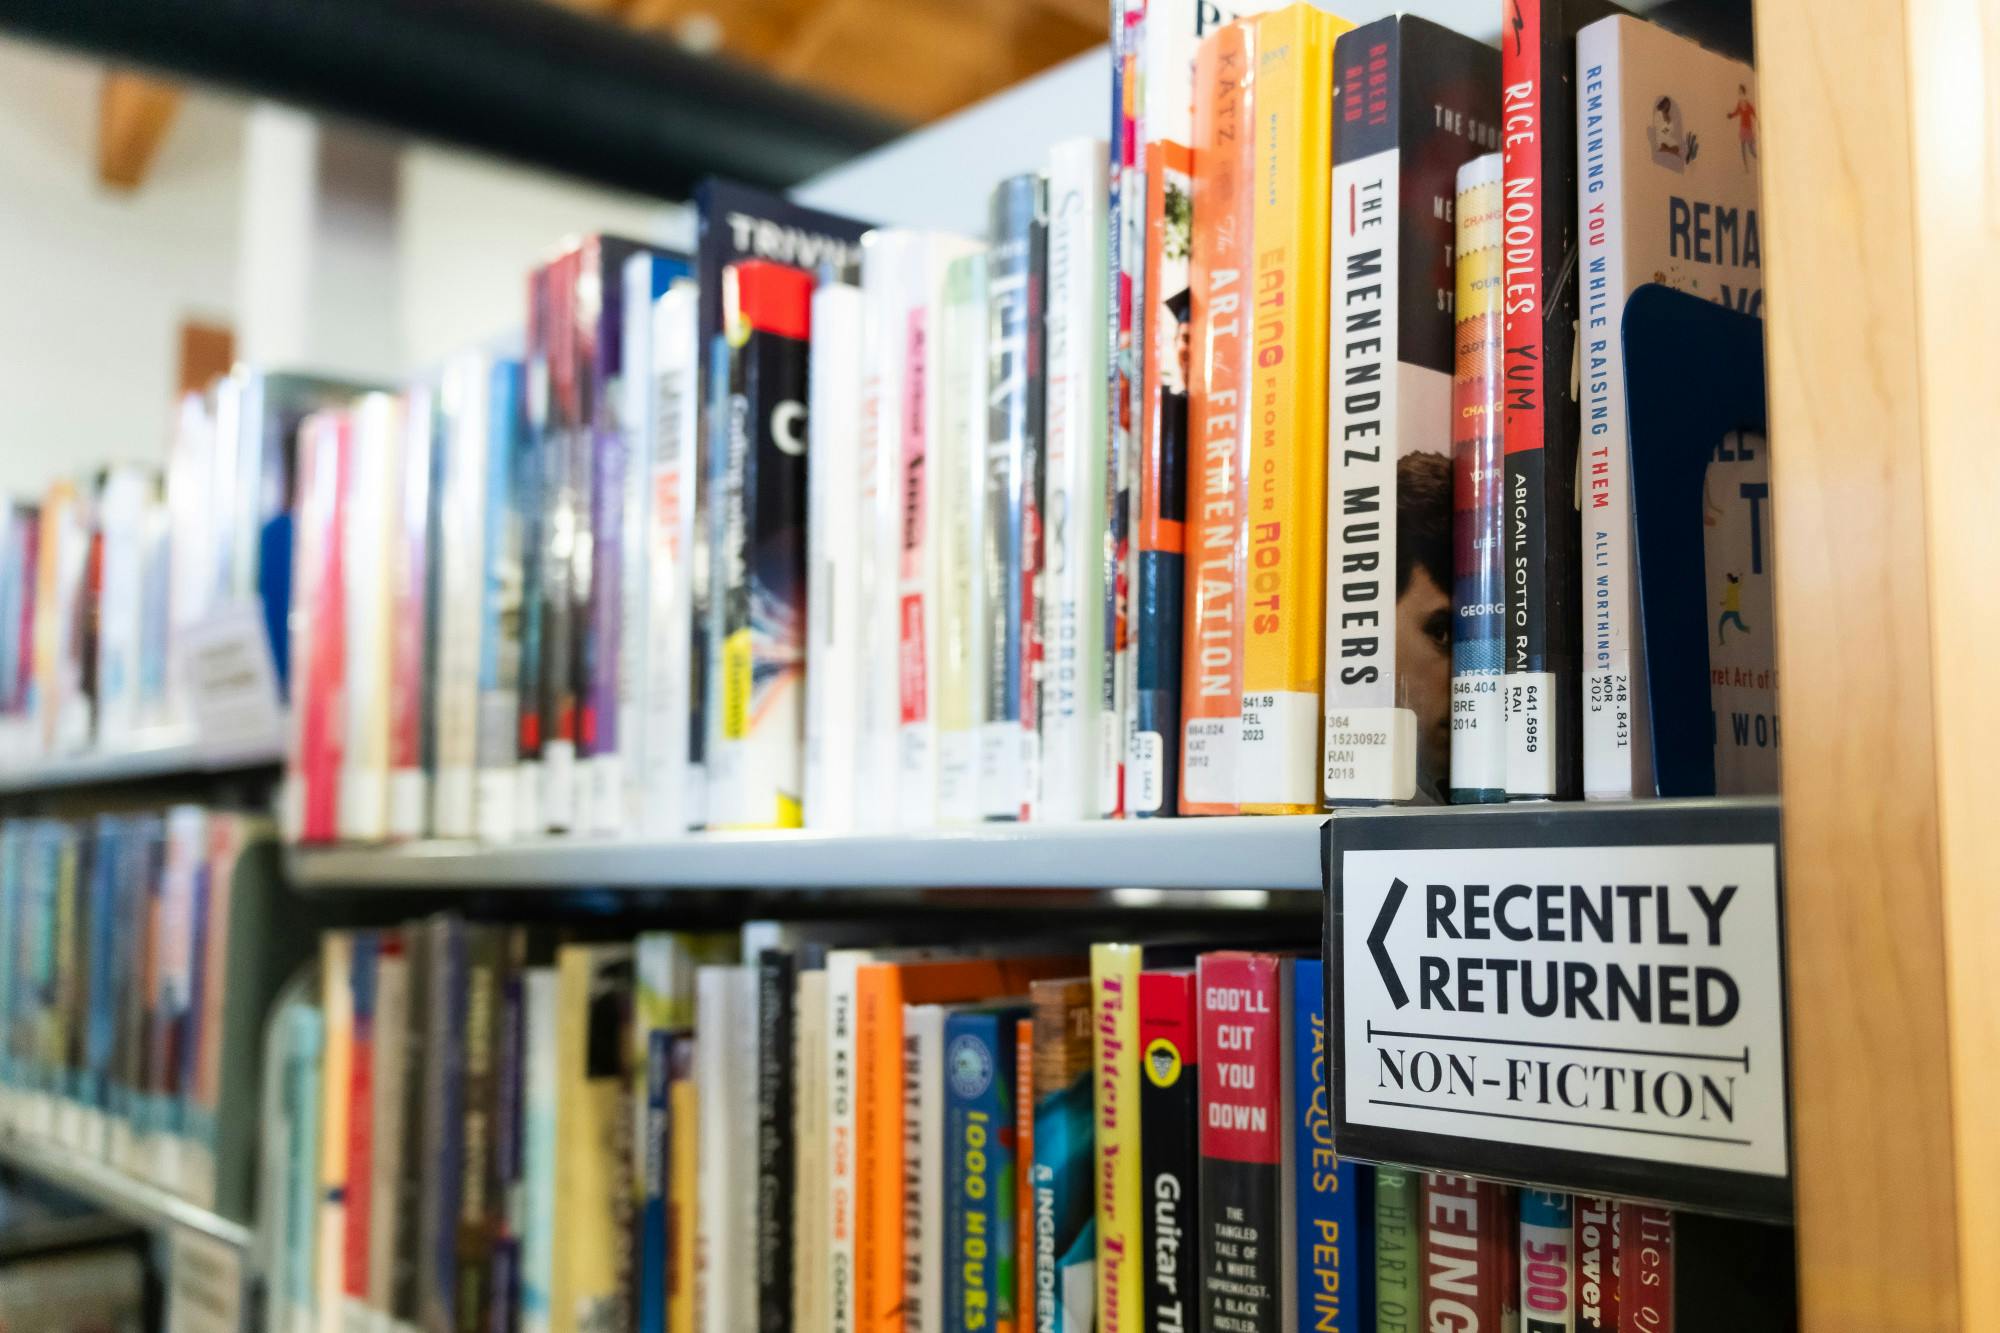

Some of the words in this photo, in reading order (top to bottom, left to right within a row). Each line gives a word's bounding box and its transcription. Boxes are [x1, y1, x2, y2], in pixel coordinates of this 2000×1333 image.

[1216, 50, 1237, 146] KATZ
[1345, 66, 1362, 122] RAND
[1369, 44, 1387, 126] ROBERT
[1435, 105, 1462, 136] THE
[1468, 119, 1502, 149] SHO
[1505, 80, 1534, 164] RICE.
[1586, 65, 1604, 194] REMAINING
[1361, 179, 1382, 230] THE
[1464, 208, 1502, 228] CHANG
[1588, 202, 1605, 247] YOU
[1669, 196, 1760, 269] REMA
[1505, 177, 1535, 331] NOODLES.
[1209, 268, 1240, 338] ART
[1589, 256, 1607, 329] WHILE
[1344, 248, 1382, 467] MENENDEZ
[1506, 345, 1538, 424] YUM.
[1590, 340, 1608, 436] RAISING
[1264, 377, 1276, 448] FROM
[1462, 401, 1503, 418] CHANG
[1263, 459, 1275, 511] OUR
[1591, 447, 1609, 509] THEM
[1201, 389, 1236, 698] FERMENTATION
[1514, 474, 1528, 551] ABIGAIL
[1253, 521, 1281, 636] ROOTS
[1595, 531, 1609, 567] ALLI
[1341, 485, 1380, 686] MURDERS
[1461, 602, 1504, 617] GEORG
[1514, 556, 1528, 627] SOTTO
[1596, 576, 1610, 671] WORTHINGT
[1514, 635, 1528, 675] RAI
[1710, 668, 1729, 686] ret
[1734, 667, 1753, 687] Art
[1758, 669, 1769, 689] of
[1454, 681, 1496, 693] 646.404
[1454, 700, 1475, 712] BRE
[1512, 686, 1523, 713] RAI
[1591, 677, 1601, 713] 2023
[1602, 675, 1613, 703] WOR
[1615, 675, 1628, 749] 248.8431
[1243, 713, 1261, 725] FEL
[1243, 729, 1264, 741] 2023
[1328, 716, 1349, 728] 364
[1453, 718, 1477, 730] 2014
[1526, 685, 1538, 753] 641.5959
[1732, 711, 1781, 749] WOR
[1328, 750, 1354, 763] RAN
[1328, 767, 1355, 779] 2018
[1426, 884, 1739, 946] RECENTLY
[834, 994, 848, 1039] THE
[1205, 987, 1270, 1015] GOD'LL
[1420, 956, 1741, 1027] RETURNED
[1099, 975, 1123, 1130] Tighten
[1217, 1026, 1254, 1051] CUT
[834, 1050, 848, 1116] KETO
[1217, 1062, 1255, 1089] YOU
[1377, 1047, 1736, 1123] NON-FICTION
[1208, 1103, 1267, 1132] DOWN
[833, 1126, 848, 1177] FOR
[964, 1111, 989, 1200] 1000
[1103, 1143, 1120, 1220] Your
[1036, 1188, 1055, 1333] INGREDIEN
[1154, 1172, 1183, 1294] Guitar
[1215, 1223, 1258, 1241] TANGLED
[1215, 1242, 1238, 1258] TALE
[1243, 1246, 1257, 1259] OF
[1378, 1204, 1407, 1289] HEART
[1429, 1172, 1478, 1333] EEING
[1640, 1210, 1671, 1287] lies
[832, 1251, 848, 1333] COOK
[962, 1210, 989, 1332] HOURS
[1215, 1260, 1223, 1273] A
[1227, 1262, 1257, 1279] WHITE
[1526, 1240, 1568, 1312] 500
[1214, 1297, 1222, 1309] A
[1225, 1299, 1259, 1316] BLACK
